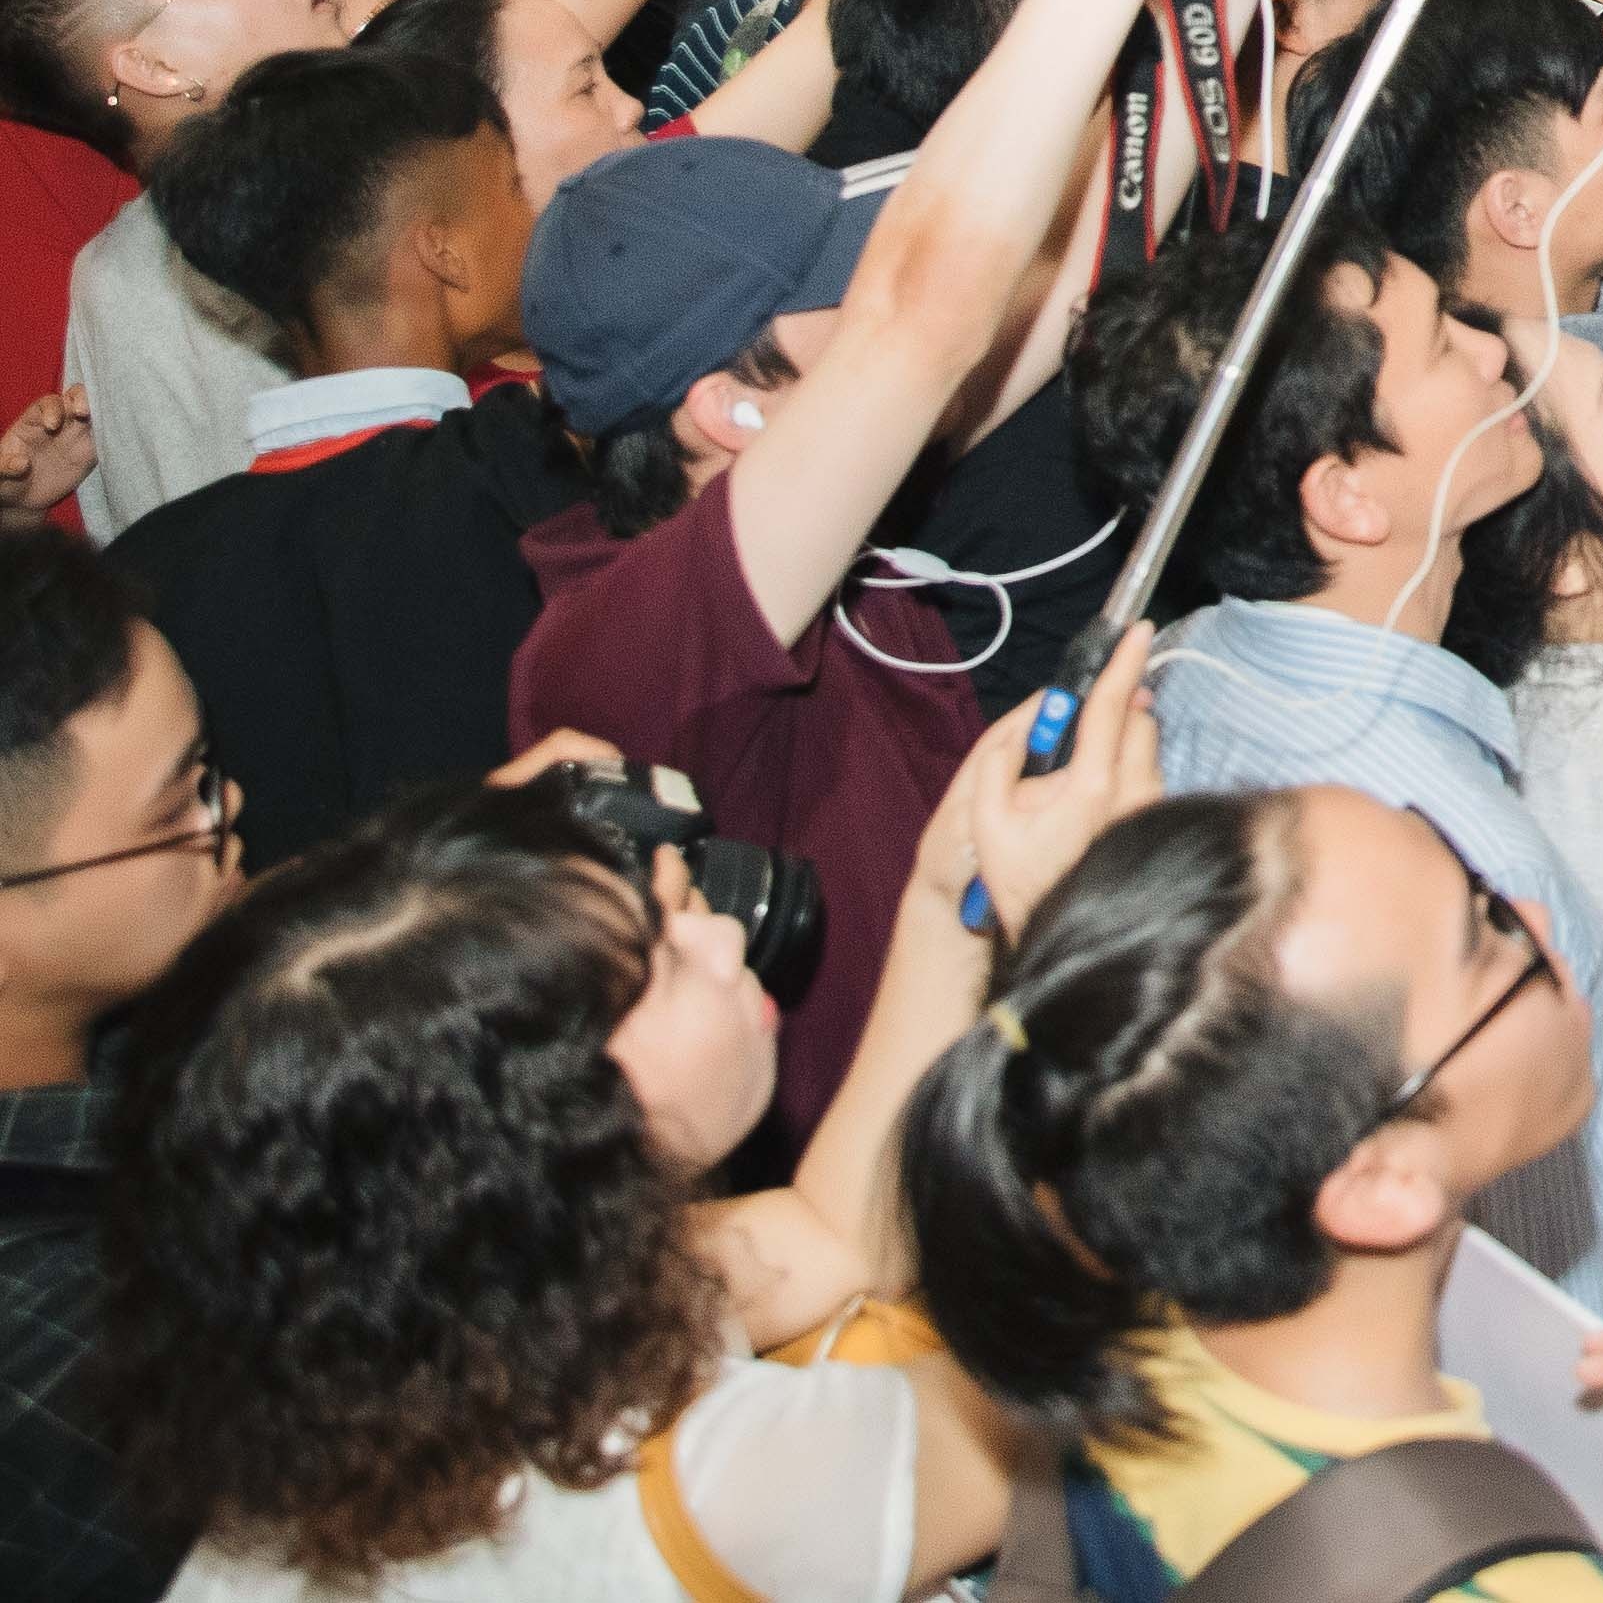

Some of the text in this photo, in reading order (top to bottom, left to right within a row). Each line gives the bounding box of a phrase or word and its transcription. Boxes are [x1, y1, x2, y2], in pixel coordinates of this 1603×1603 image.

[1117, 91, 1150, 210] Canon
[1184, 2, 1231, 164] EOS 60D
